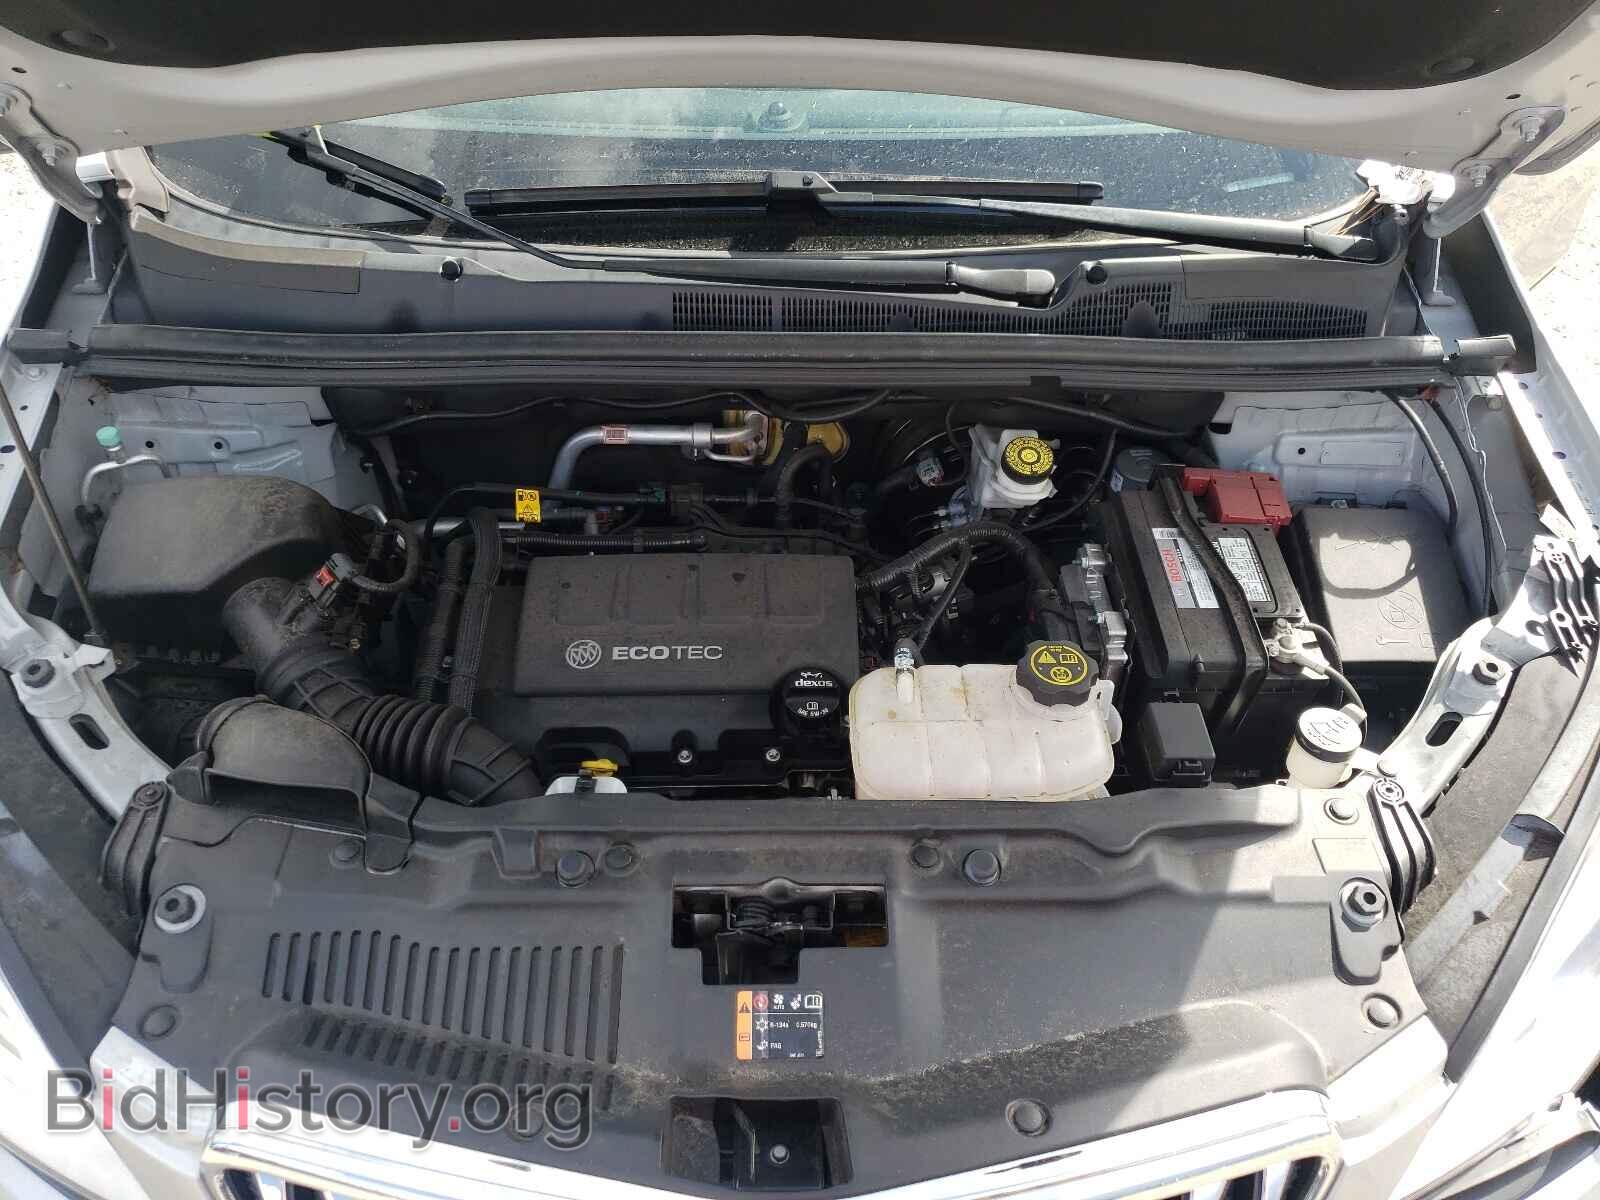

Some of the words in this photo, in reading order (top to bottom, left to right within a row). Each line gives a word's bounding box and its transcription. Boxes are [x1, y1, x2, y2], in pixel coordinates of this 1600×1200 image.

[1161, 550, 1185, 582] BOSCH
[611, 645, 723, 660] ECOTEC
[795, 679, 833, 687] dexos
